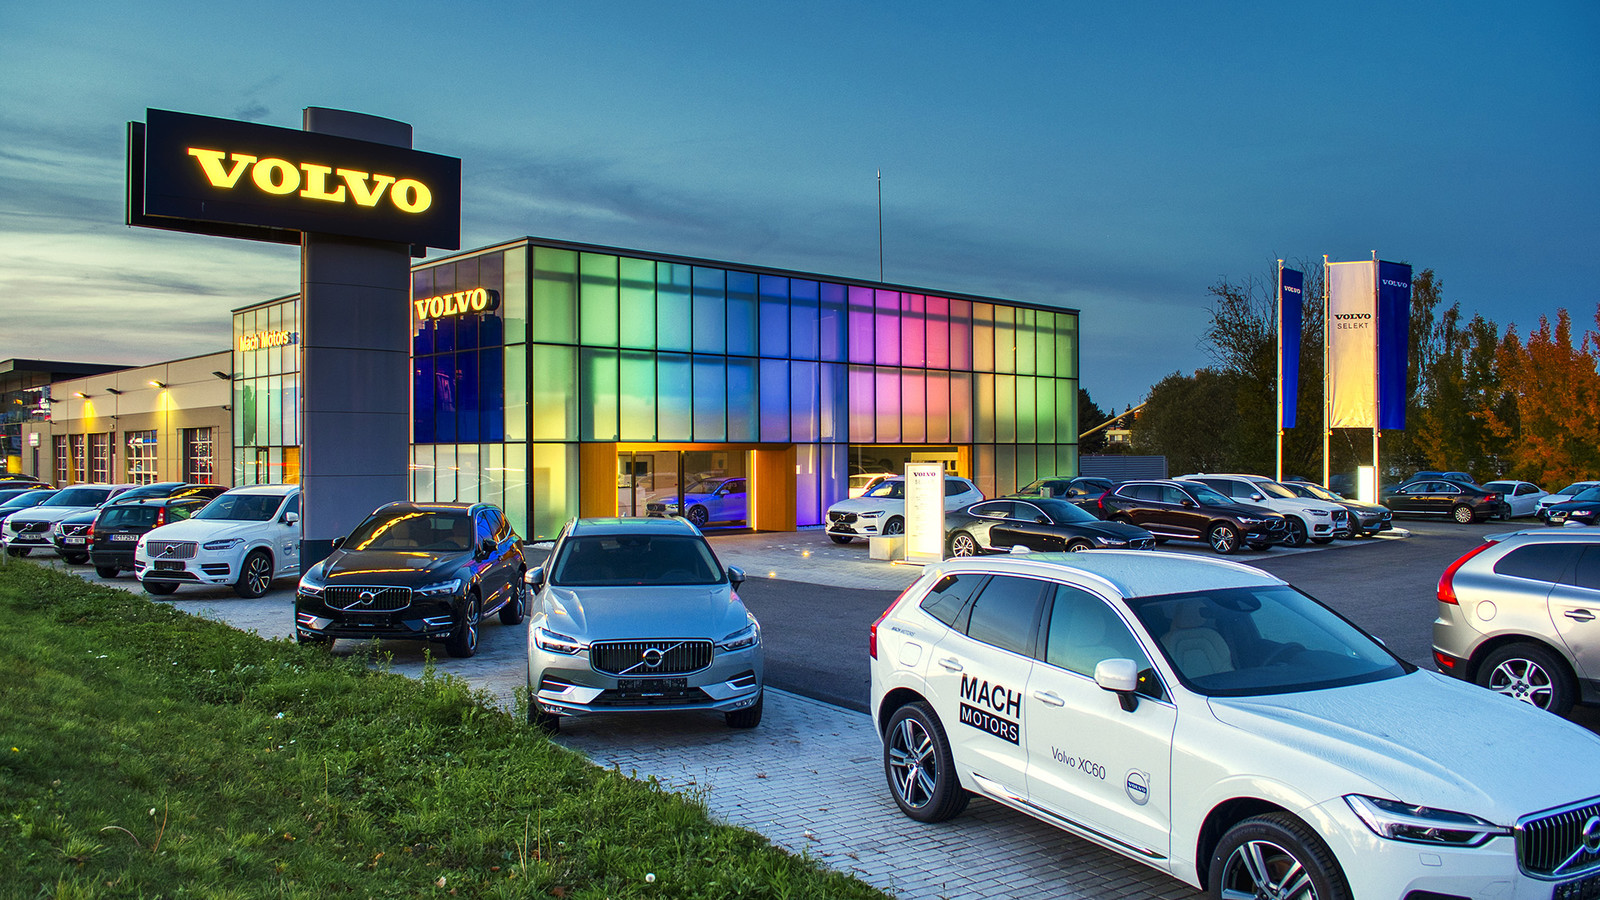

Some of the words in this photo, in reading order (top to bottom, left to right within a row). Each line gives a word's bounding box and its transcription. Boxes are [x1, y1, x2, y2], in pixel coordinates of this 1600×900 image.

[187, 147, 433, 214] VOLVO
[1284, 285, 1301, 294] VOLVO
[1383, 279, 1408, 289] VOLVO
[413, 287, 488, 321] VOLVO
[239, 333, 259, 352] Mach
[259, 330, 289, 348] Motors
[960, 673, 1022, 719] MACH
[961, 706, 1019, 742] MOTORS
[1051, 746, 1076, 768] Volvo
[1078, 757, 1106, 780] XC60
